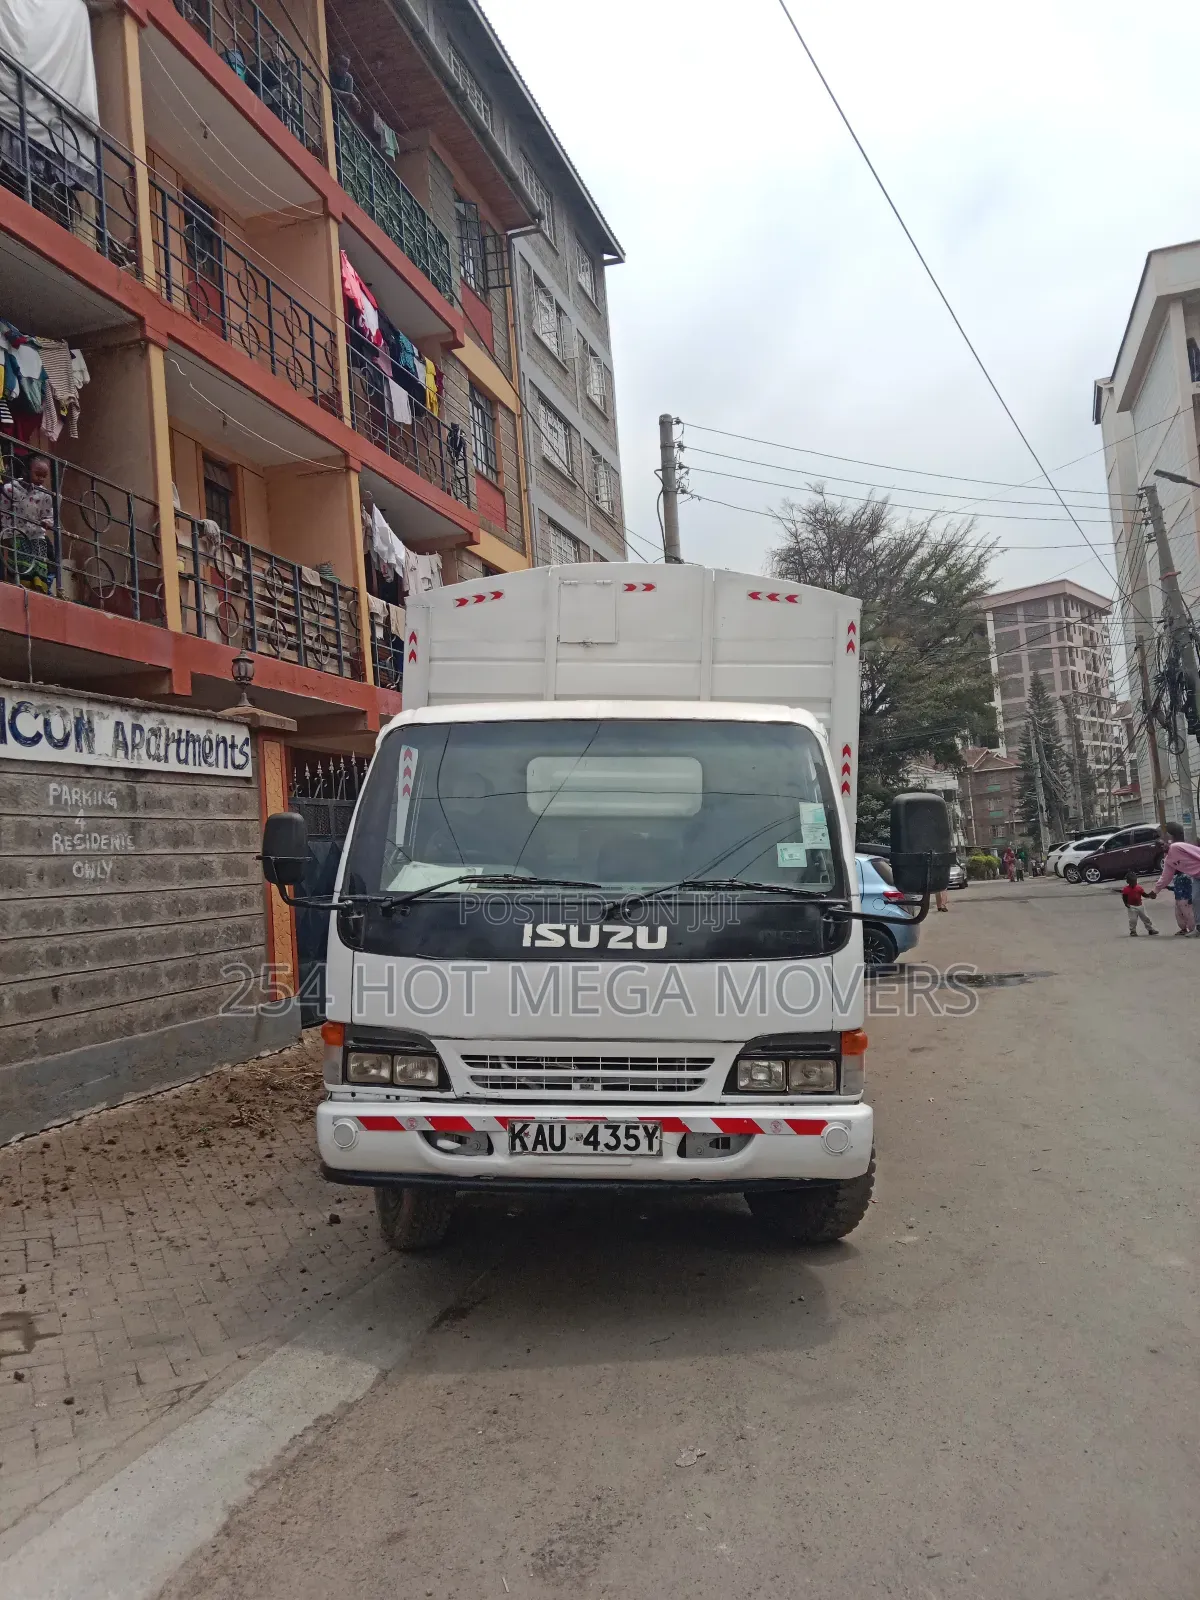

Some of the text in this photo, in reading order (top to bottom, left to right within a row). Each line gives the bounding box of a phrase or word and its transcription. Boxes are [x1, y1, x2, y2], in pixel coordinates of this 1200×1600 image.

[75, 808, 87, 831] 4
[72, 858, 113, 880] ONLY
[522, 923, 668, 950] ISUZU
[510, 1123, 660, 1152] KAU 435Y
